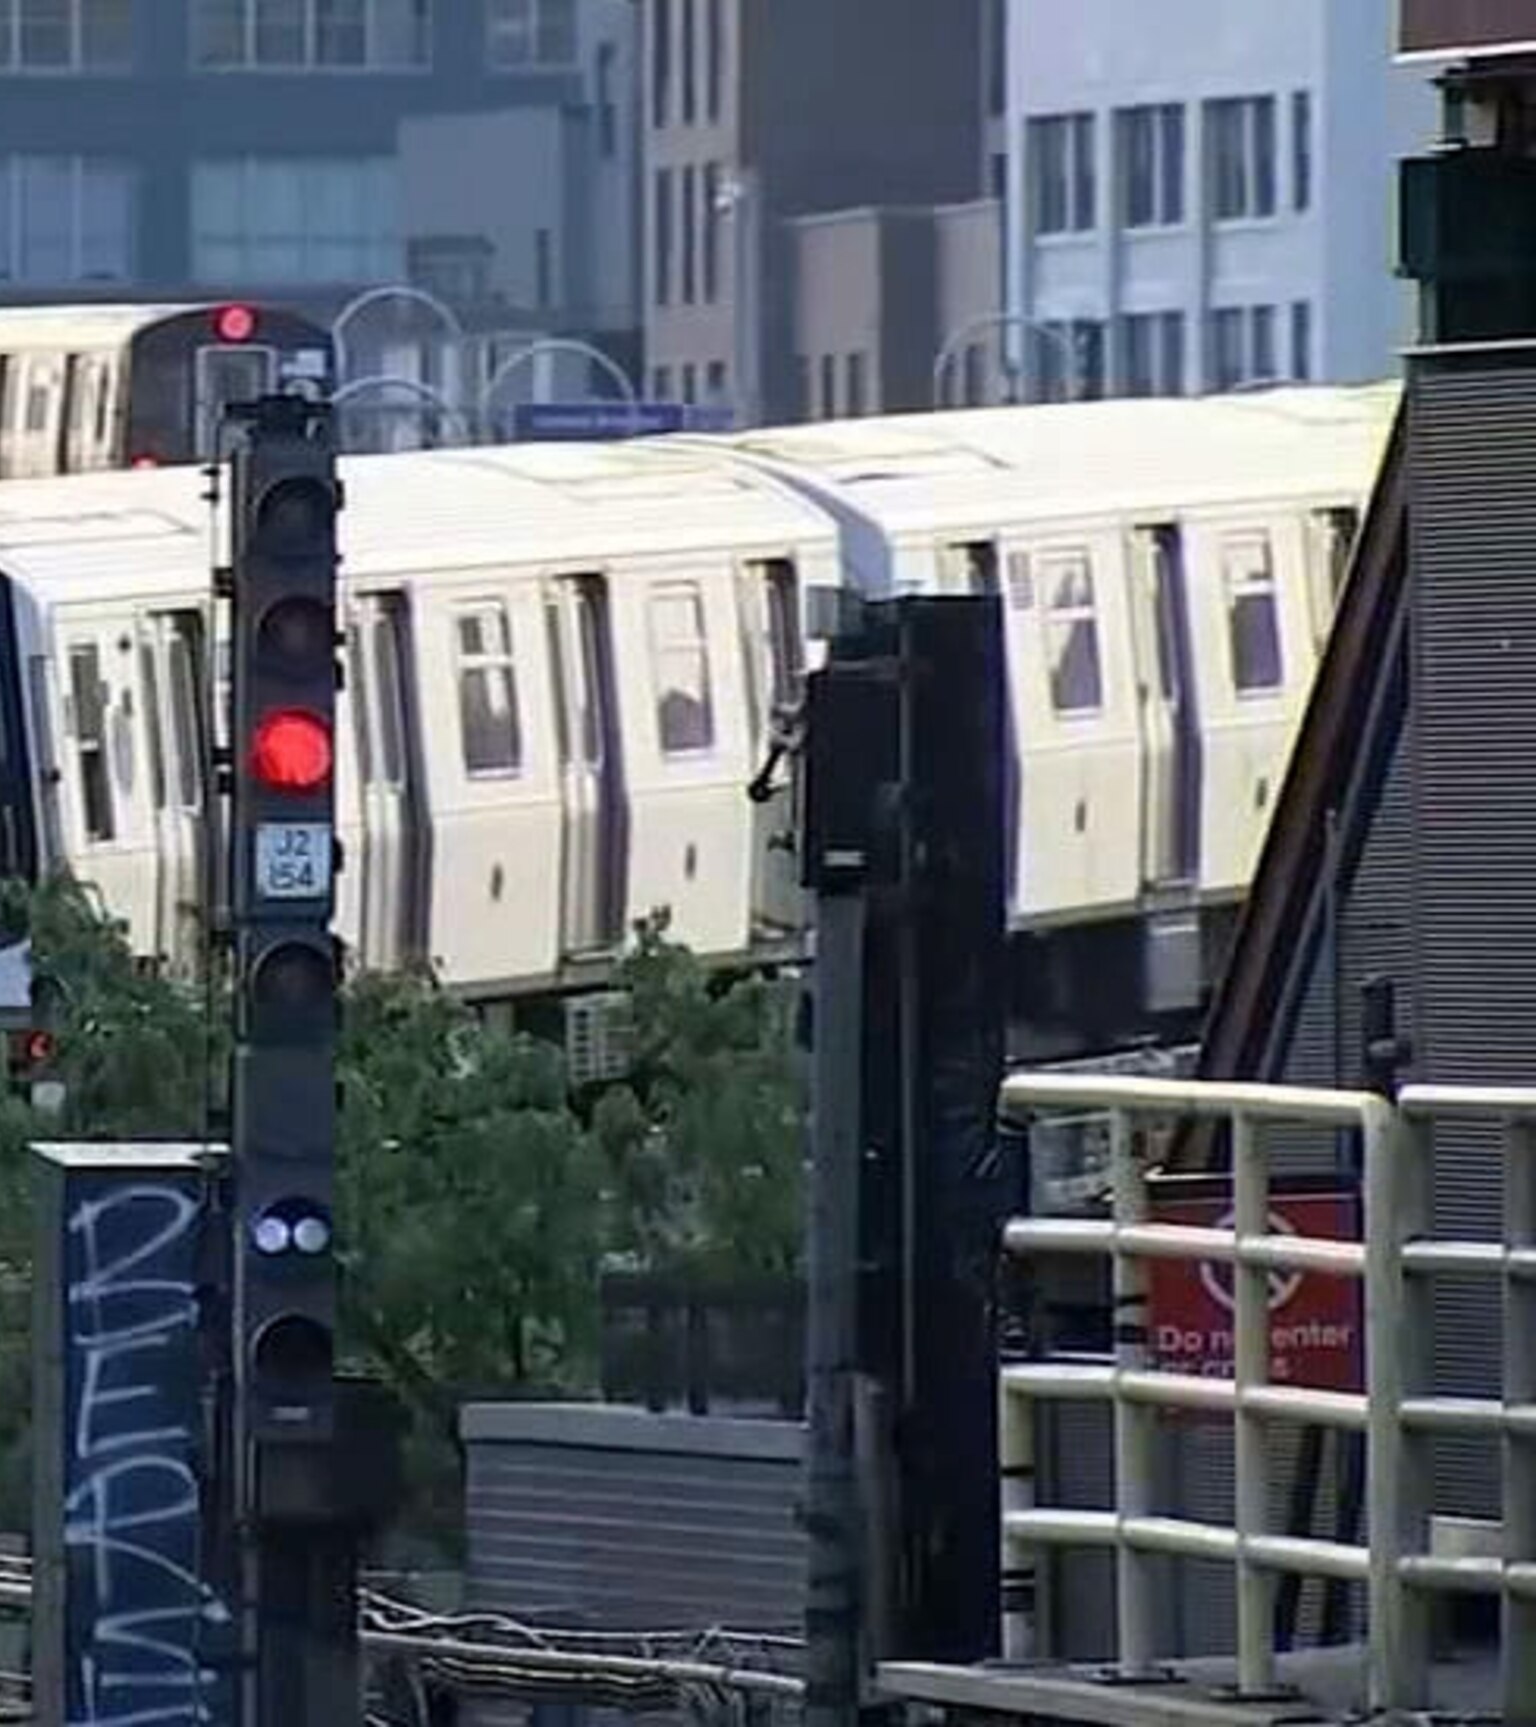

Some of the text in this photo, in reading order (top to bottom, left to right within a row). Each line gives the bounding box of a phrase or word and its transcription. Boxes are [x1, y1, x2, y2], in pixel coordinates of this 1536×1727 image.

[275, 829, 311, 856] J2
[1158, 1326, 1202, 1350] Do
[1272, 1320, 1351, 1347] enter
